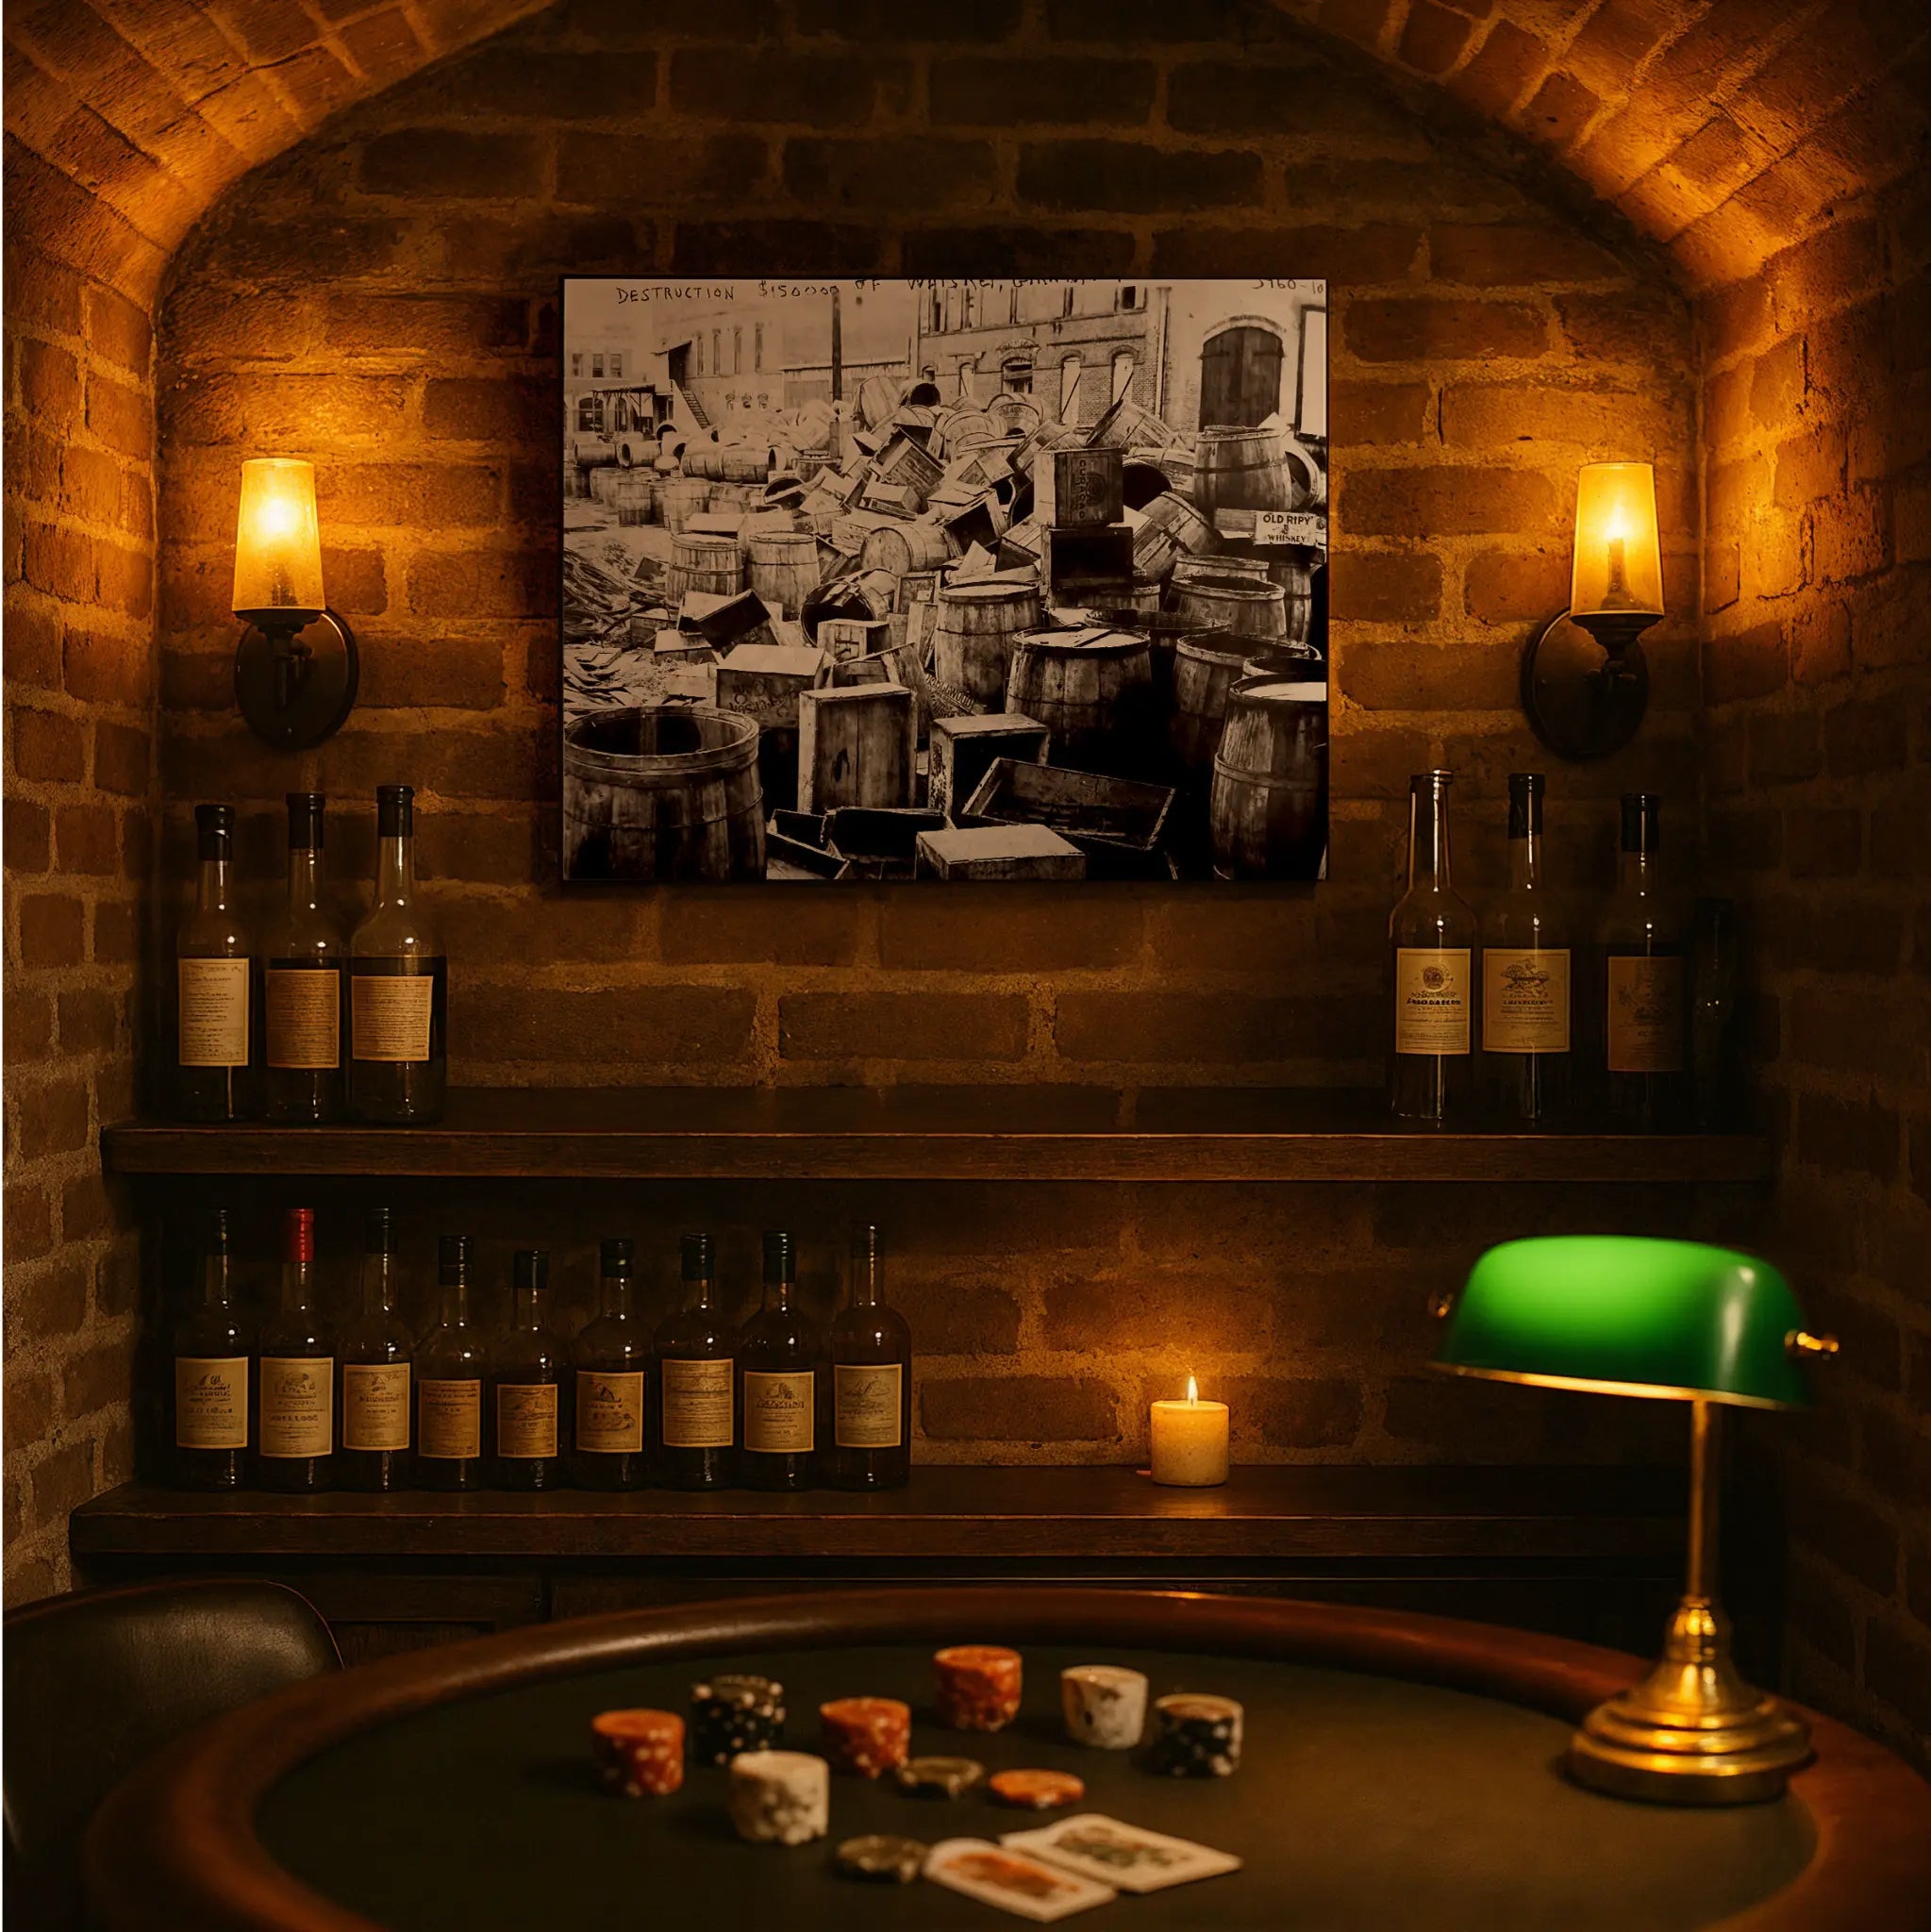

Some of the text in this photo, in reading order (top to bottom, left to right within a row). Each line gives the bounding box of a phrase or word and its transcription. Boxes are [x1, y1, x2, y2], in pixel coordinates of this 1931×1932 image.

[617, 286, 734, 304] DESTRUCTION
[856, 279, 880, 291] OF
[1263, 514, 1285, 524] OLD
[1268, 534, 1307, 542] WHISKEY
